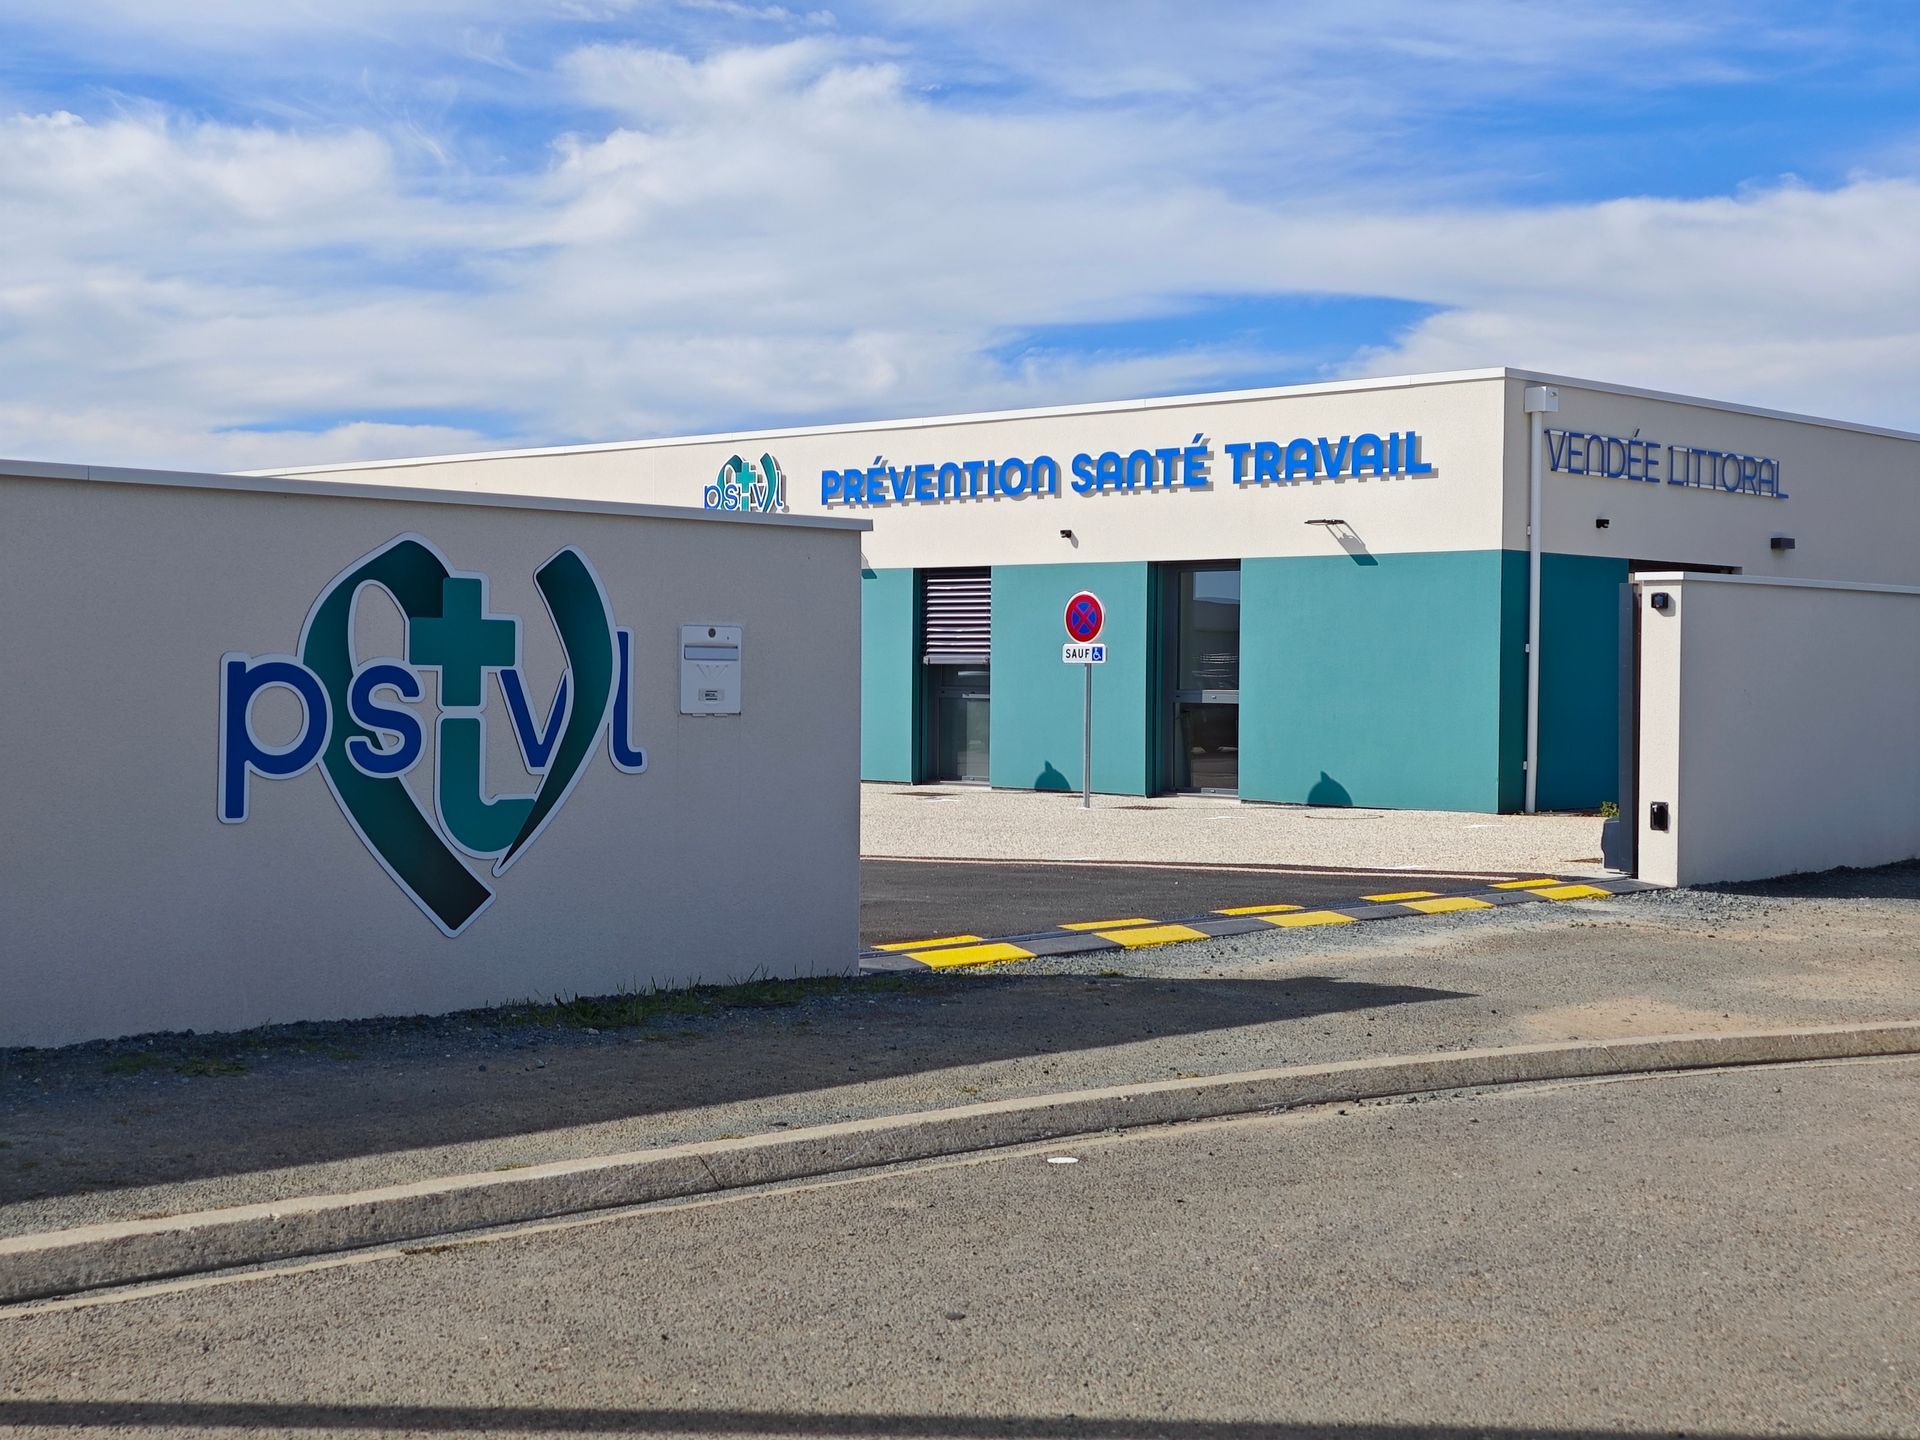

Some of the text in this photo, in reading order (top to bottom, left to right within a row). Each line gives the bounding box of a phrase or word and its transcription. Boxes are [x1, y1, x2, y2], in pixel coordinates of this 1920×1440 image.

[821, 431, 1433, 505] PRÉVENTION SANTÉ TRAVAIL
[1544, 428, 1789, 499] VENDÉE LITTORAL
[1065, 648, 1090, 659] SAUF
